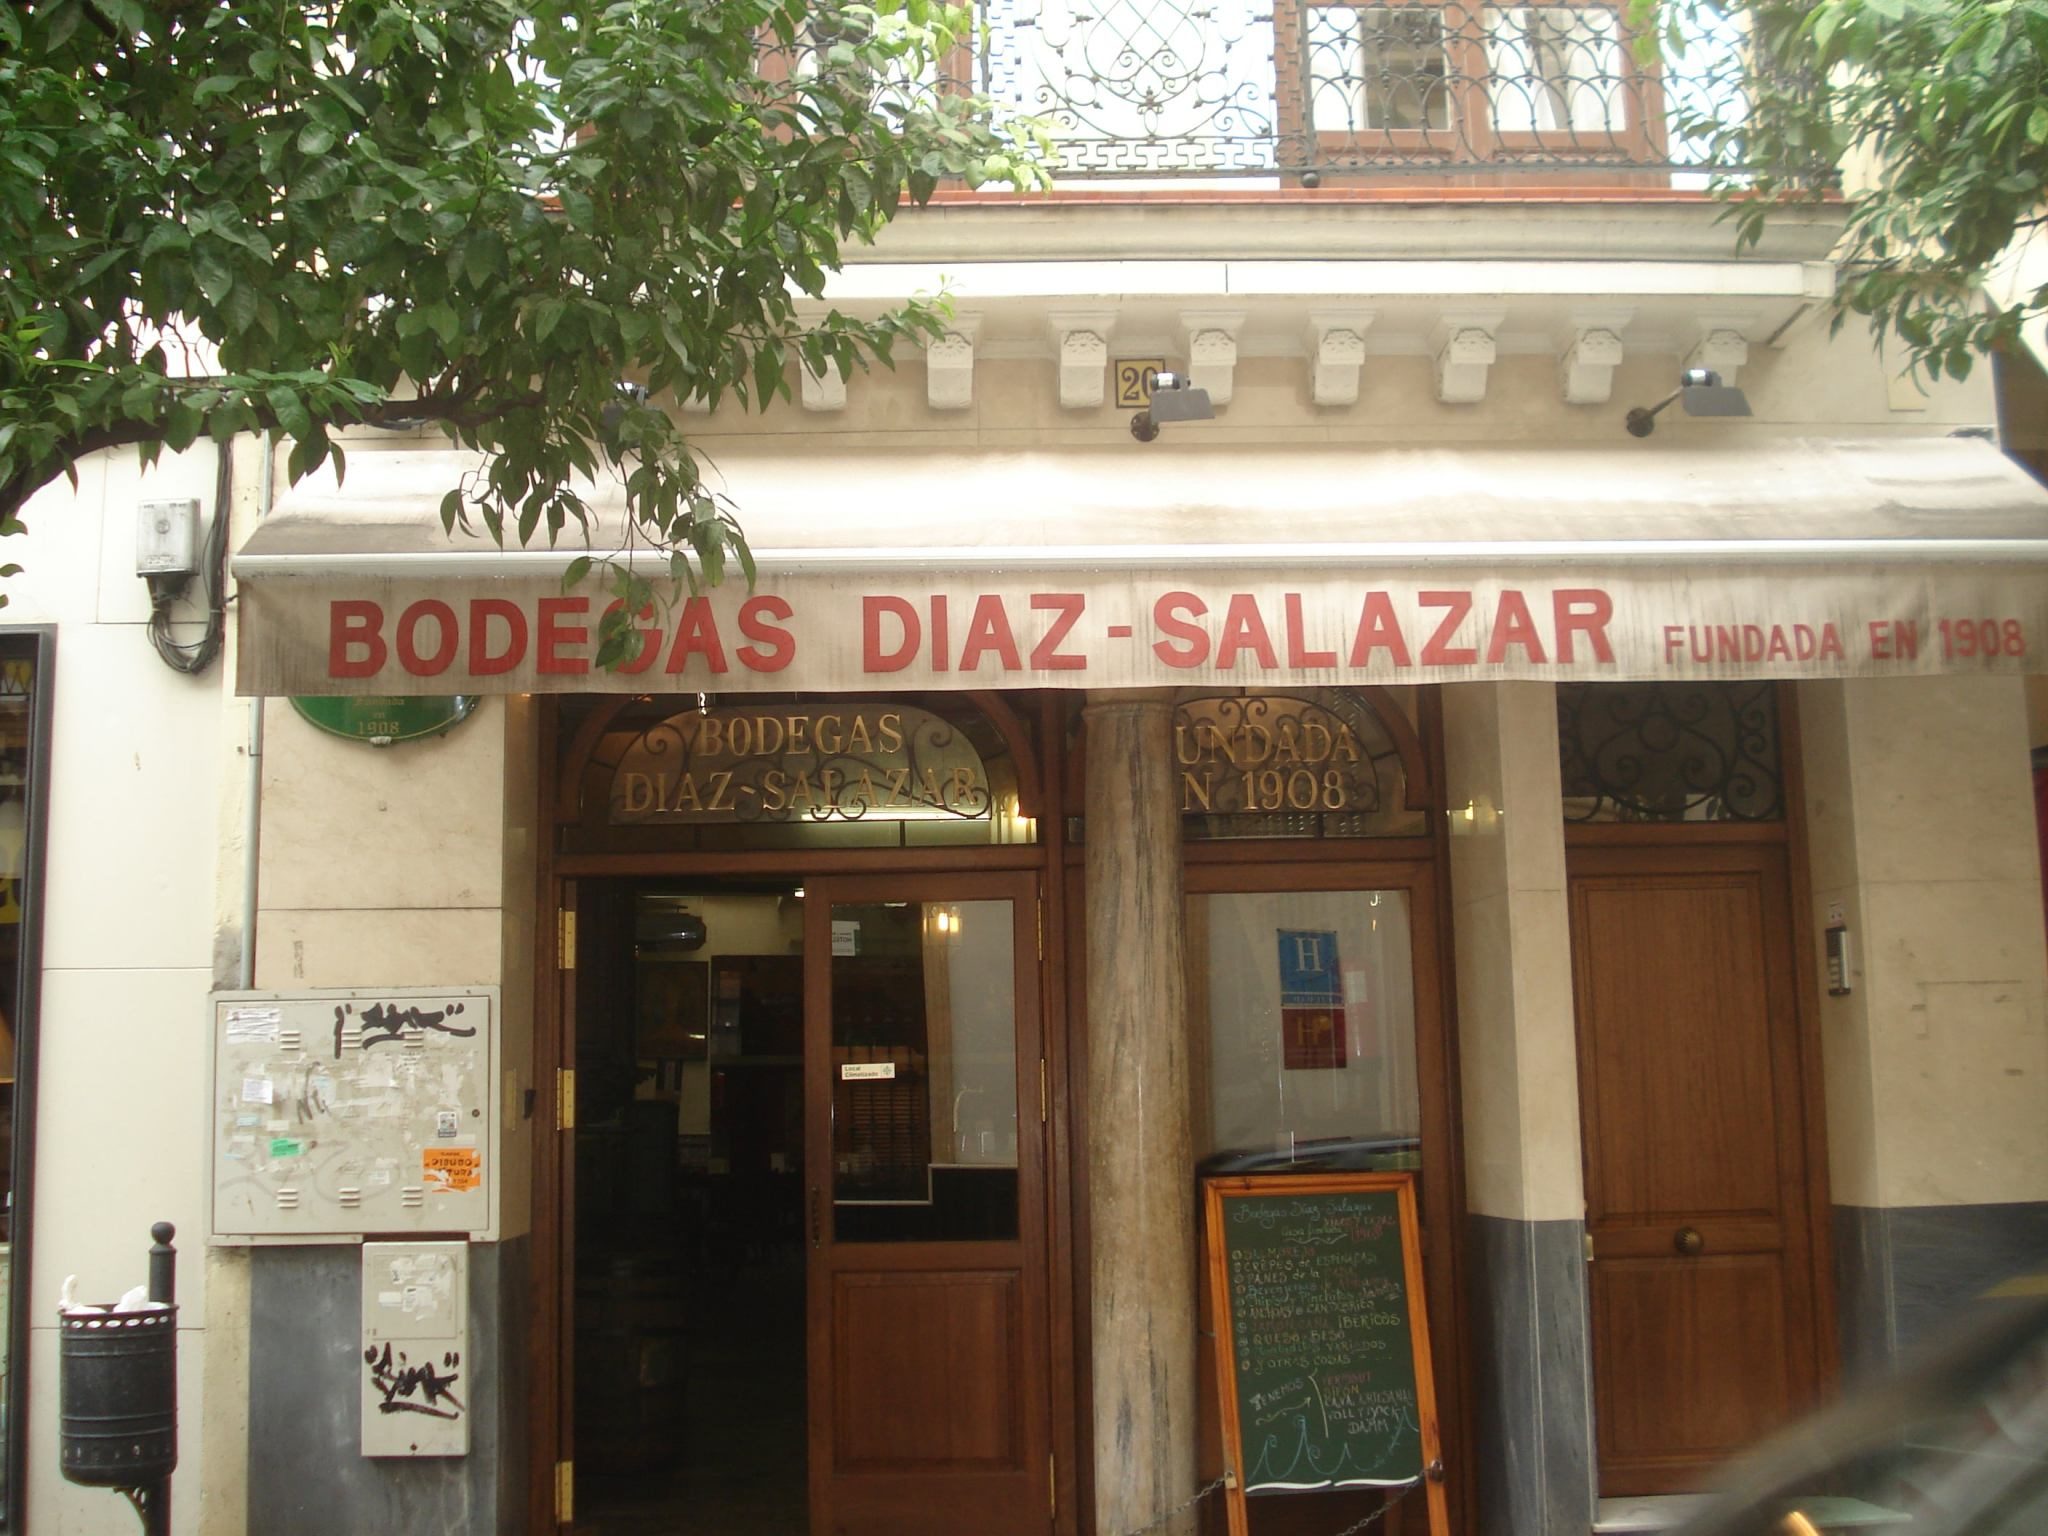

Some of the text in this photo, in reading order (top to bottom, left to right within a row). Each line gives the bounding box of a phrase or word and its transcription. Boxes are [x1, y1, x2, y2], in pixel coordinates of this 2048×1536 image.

[1121, 366, 1158, 401] 20
[329, 588, 2025, 678] BODEGAS DIAZ-SALAZAR FUNDADA EN 1908
[358, 720, 400, 735] 1908
[698, 713, 902, 757] BODEGAS
[1174, 723, 1360, 765] UNDADA
[623, 766, 978, 814] DIAZ-SALAZAR
[1180, 769, 1347, 811] N 1908
